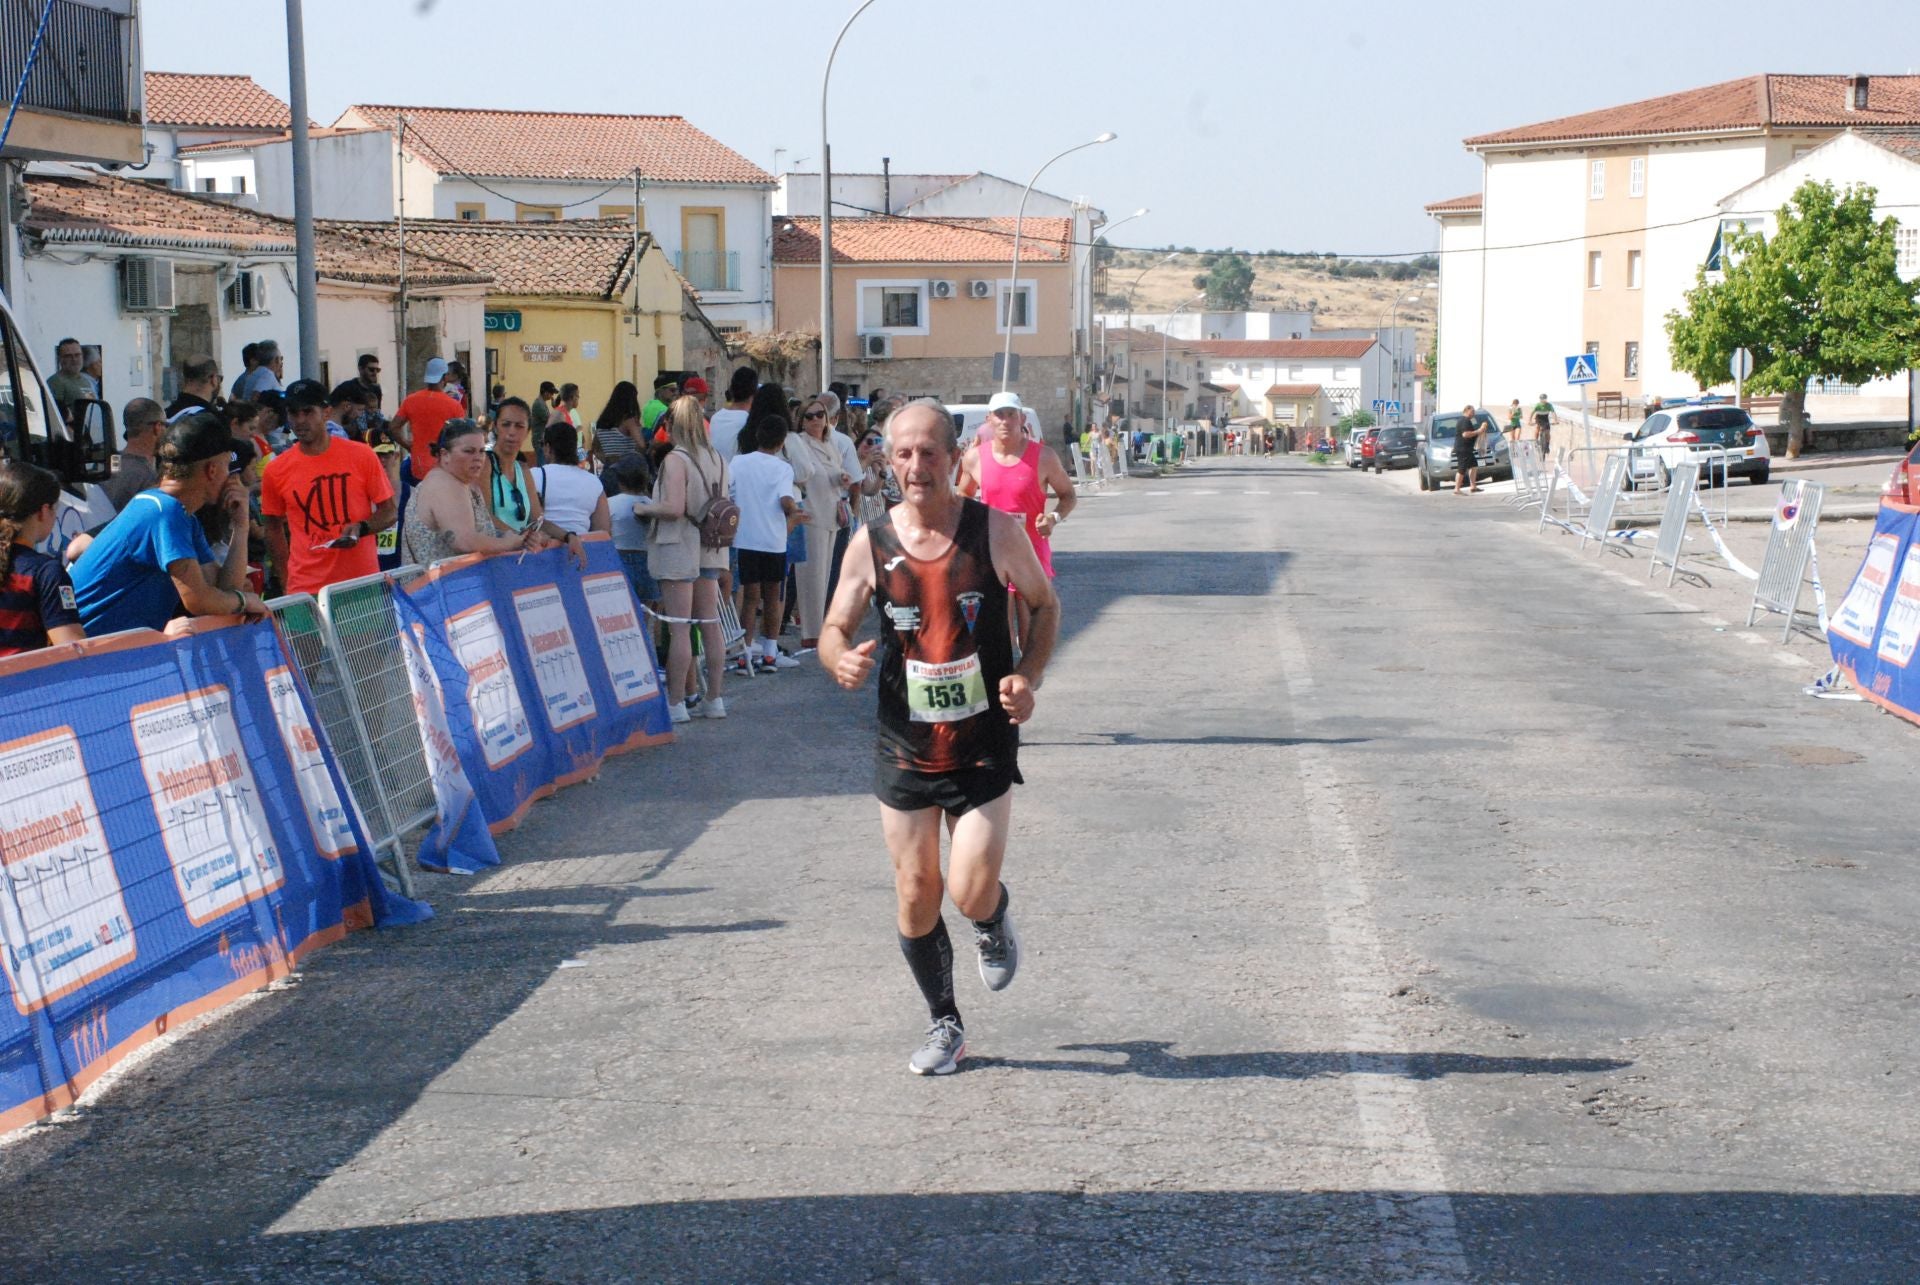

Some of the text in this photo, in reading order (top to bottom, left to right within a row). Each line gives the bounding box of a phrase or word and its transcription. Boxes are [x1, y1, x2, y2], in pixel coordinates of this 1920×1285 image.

[293, 472, 351, 535] XIII
[376, 533, 393, 548] 26
[924, 683, 966, 708] 153
